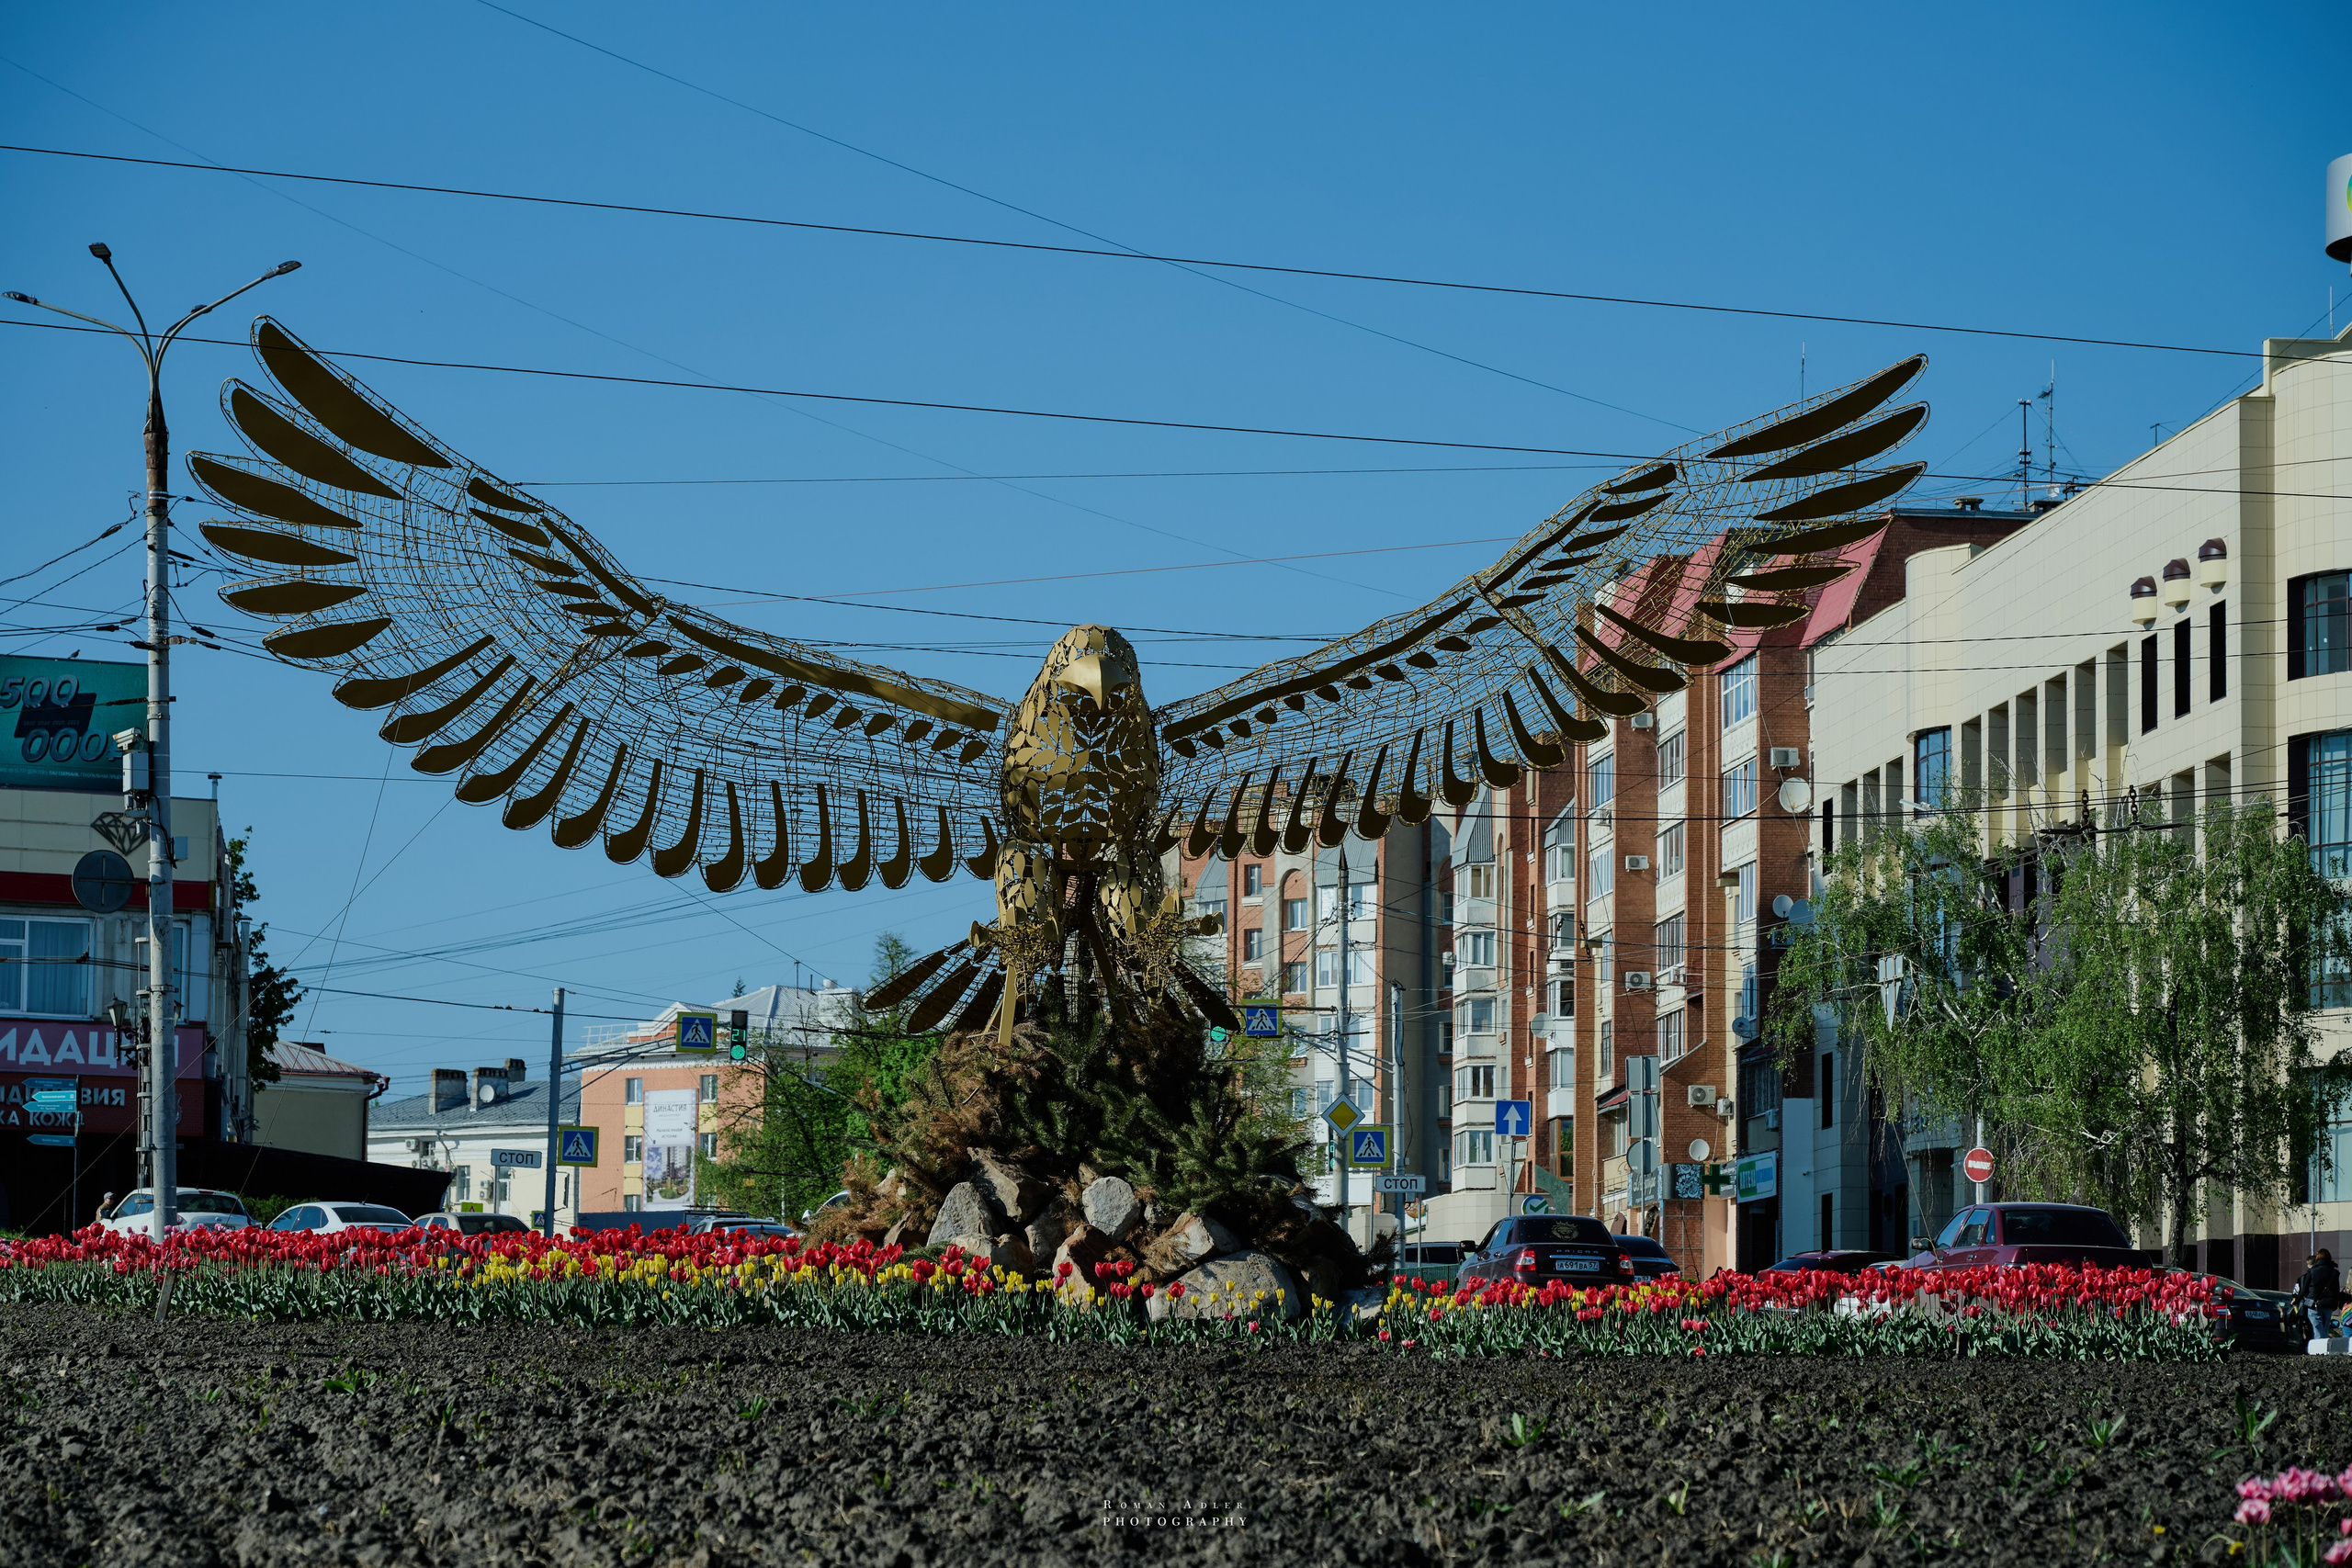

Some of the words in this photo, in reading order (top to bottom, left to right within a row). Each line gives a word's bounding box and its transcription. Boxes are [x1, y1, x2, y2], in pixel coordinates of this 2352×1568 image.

[731, 1028, 746, 1042] 21
[653, 1103, 687, 1112] ДИНАСТИЯ
[499, 1152, 534, 1165] СТОП
[1384, 1179, 1418, 1190] СТОП
